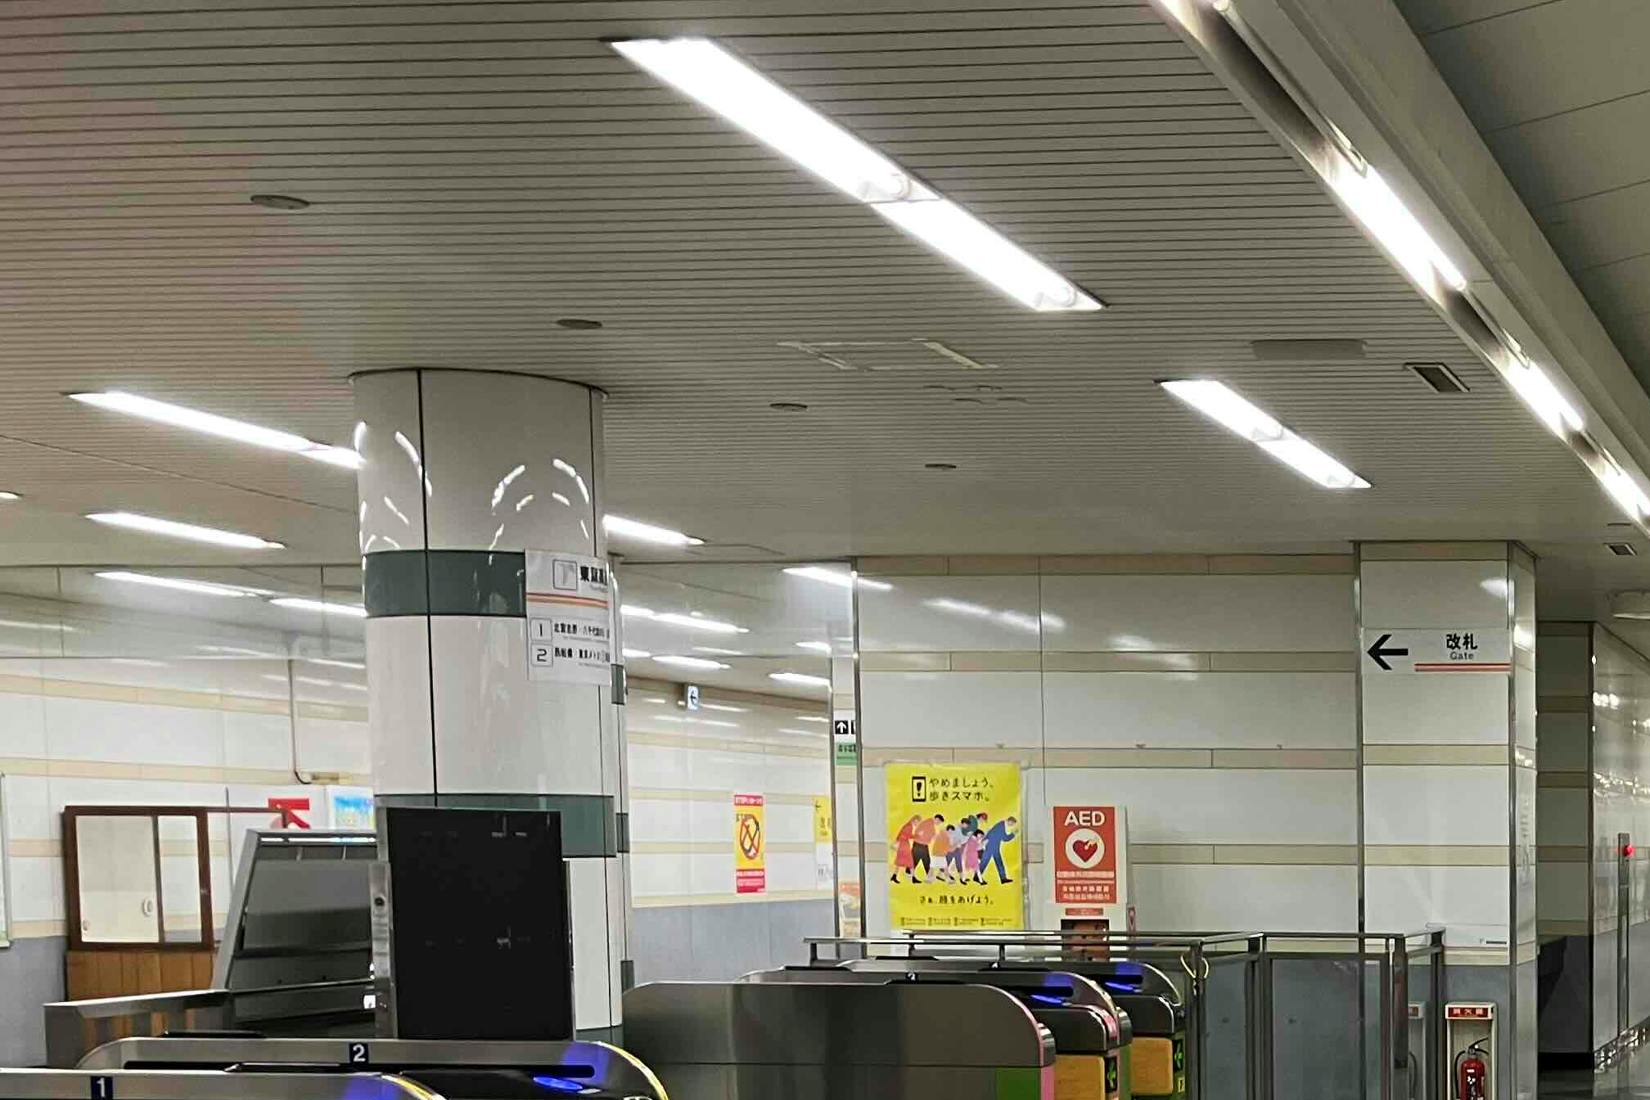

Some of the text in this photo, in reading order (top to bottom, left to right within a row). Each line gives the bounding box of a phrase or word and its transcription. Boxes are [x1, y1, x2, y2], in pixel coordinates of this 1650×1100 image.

[1445, 632, 1478, 650] 改札
[536, 648, 548, 662] 2
[1450, 650, 1475, 660] Gate
[929, 776, 994, 789] やめましょう、
[1064, 810, 1105, 827] AED
[352, 1044, 365, 1062] 2
[96, 1077, 107, 1098] 1
